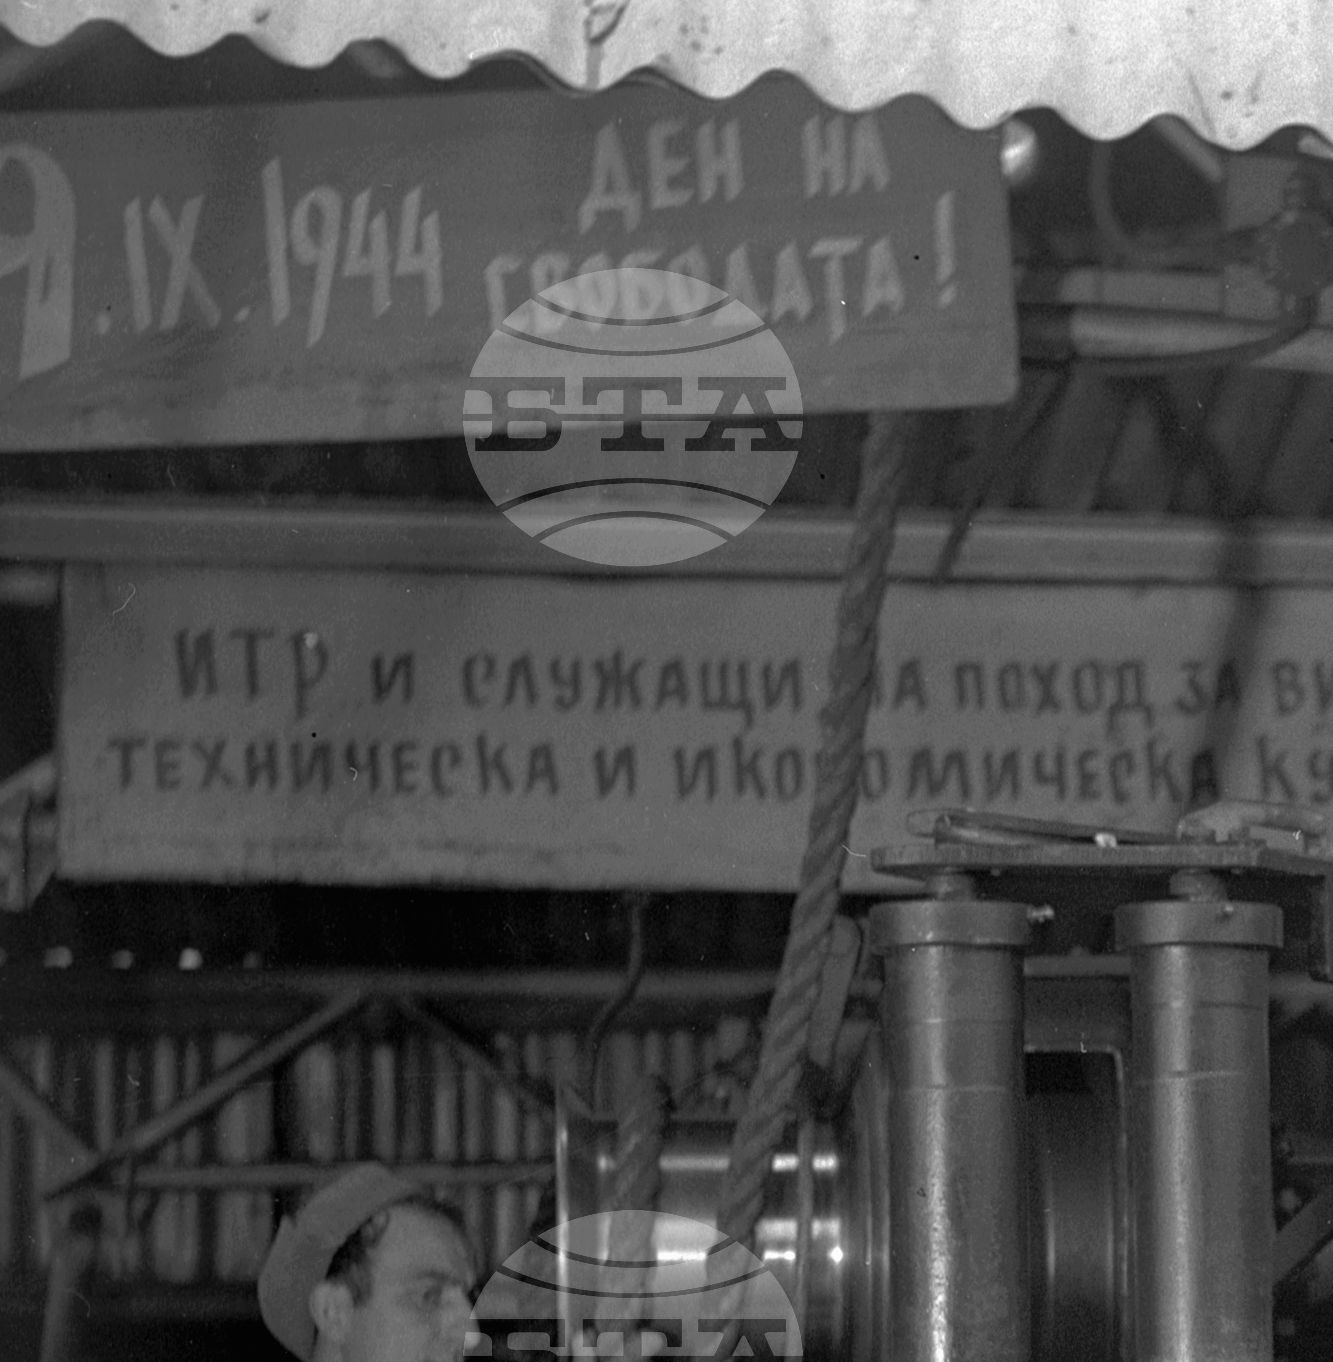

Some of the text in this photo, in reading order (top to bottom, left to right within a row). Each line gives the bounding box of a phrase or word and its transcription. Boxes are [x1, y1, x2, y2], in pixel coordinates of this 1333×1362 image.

[576, 112, 892, 235] ДЕН НА
[172, 627, 331, 718] ИТР
[460, 648, 803, 731] СЛУЖАЩИ
[953, 658, 1153, 738] ПОХОД
[1176, 660, 1242, 716] ЗА
[107, 732, 561, 797] ТЕХНИЧЕСКА
[673, 736, 1220, 803] ИКООМИЧЕСКА
